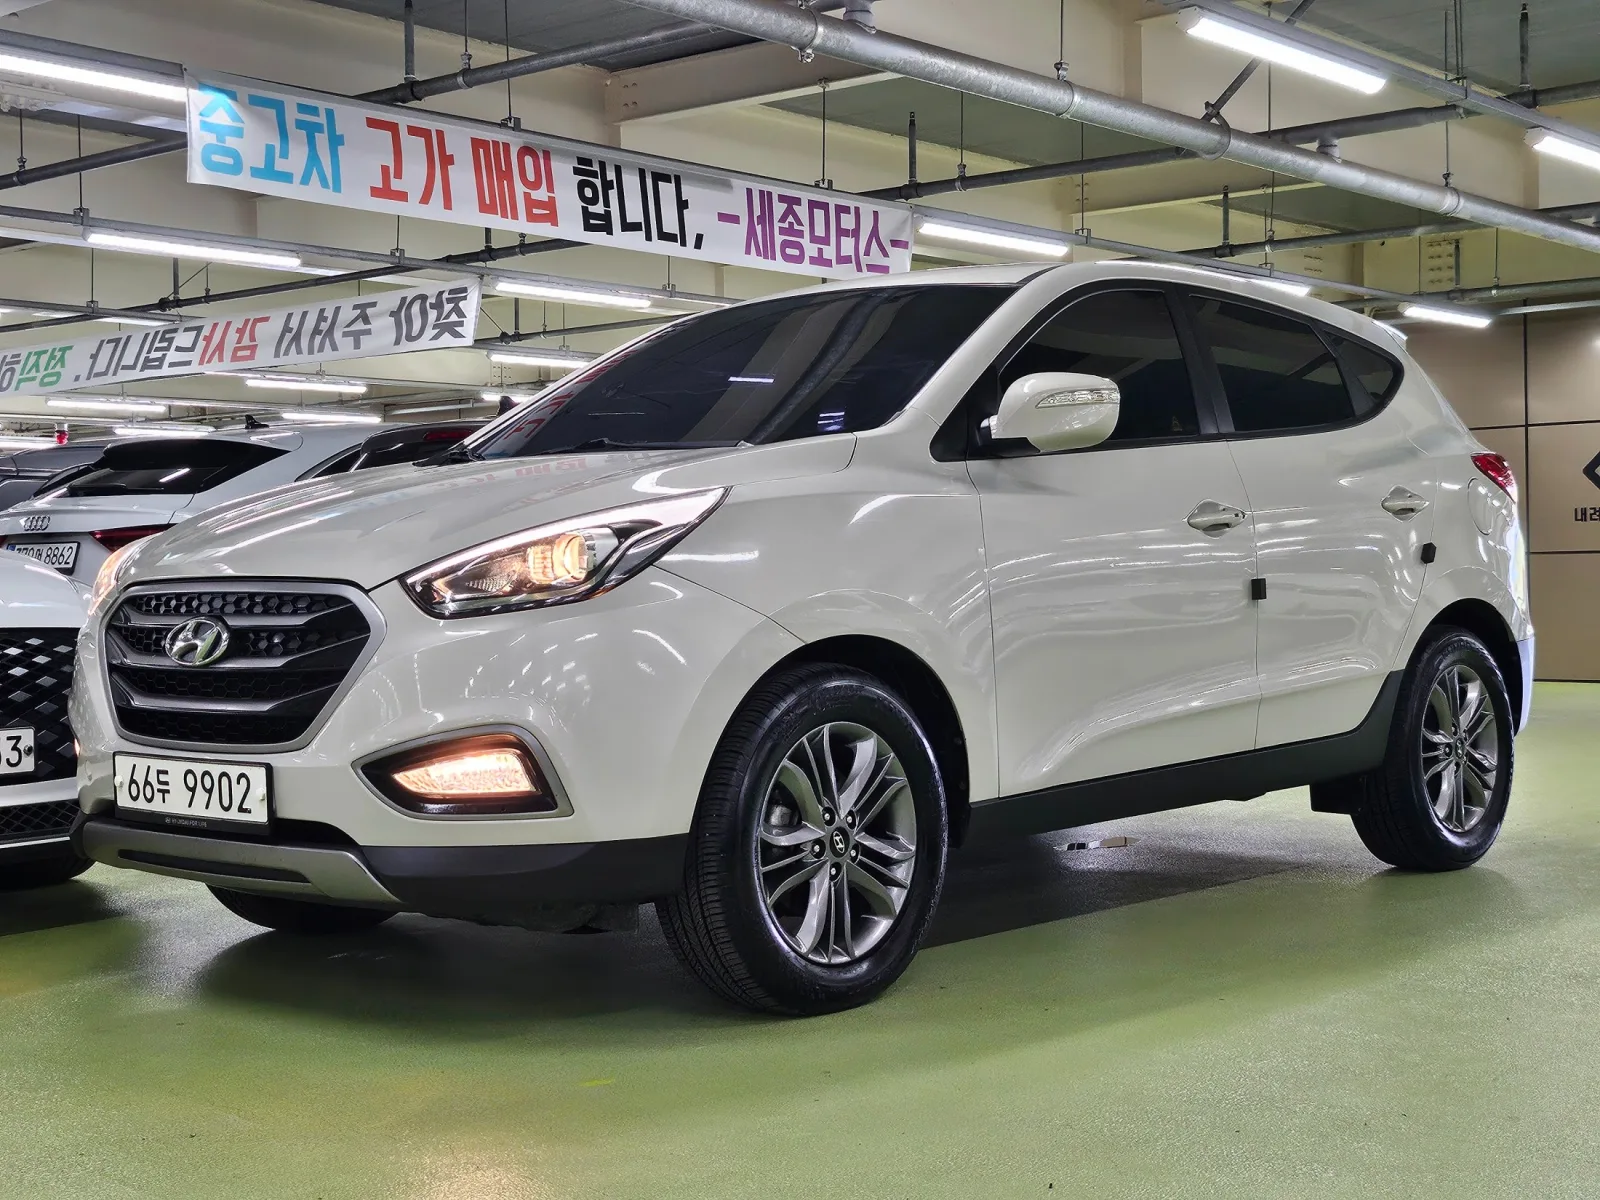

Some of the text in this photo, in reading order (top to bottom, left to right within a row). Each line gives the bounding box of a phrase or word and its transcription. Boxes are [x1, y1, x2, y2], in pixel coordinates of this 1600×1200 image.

[198, 82, 345, 193] 중고차
[365, 116, 455, 211] 고가
[470, 136, 559, 227] 매입
[572, 156, 704, 250] 합니다,
[44, 545, 74, 566] 8862
[128, 763, 252, 814] 66두 9902
